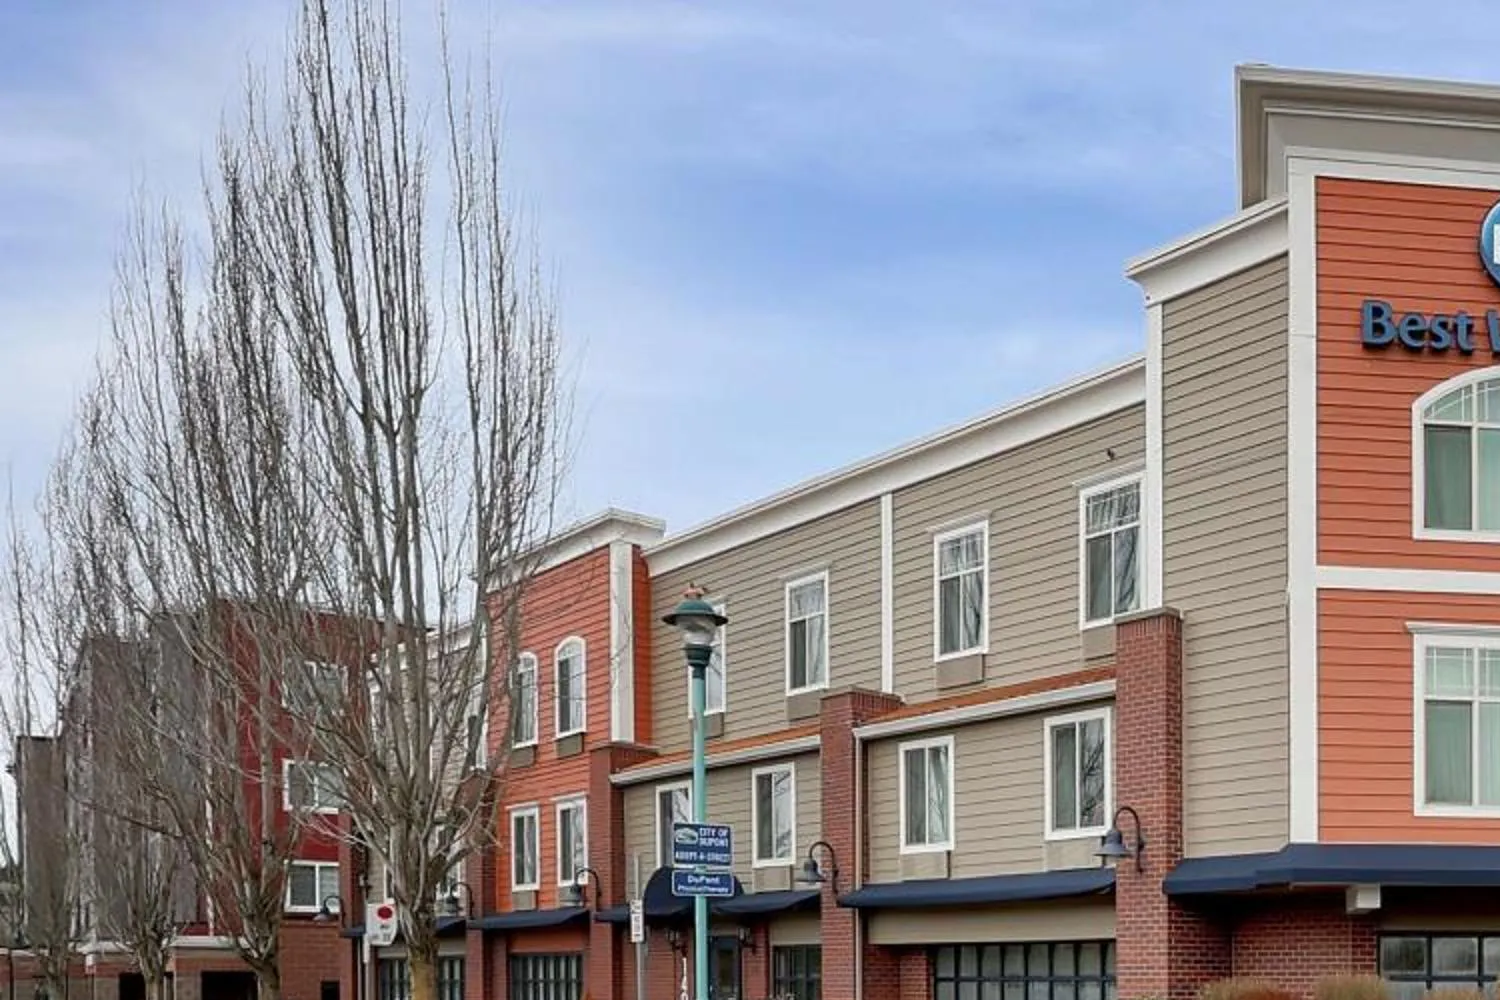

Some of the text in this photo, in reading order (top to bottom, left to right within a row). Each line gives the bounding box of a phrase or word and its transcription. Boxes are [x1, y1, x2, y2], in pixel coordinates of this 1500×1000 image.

[1361, 298, 1474, 351] Best
[699, 827, 728, 837] CITY OF
